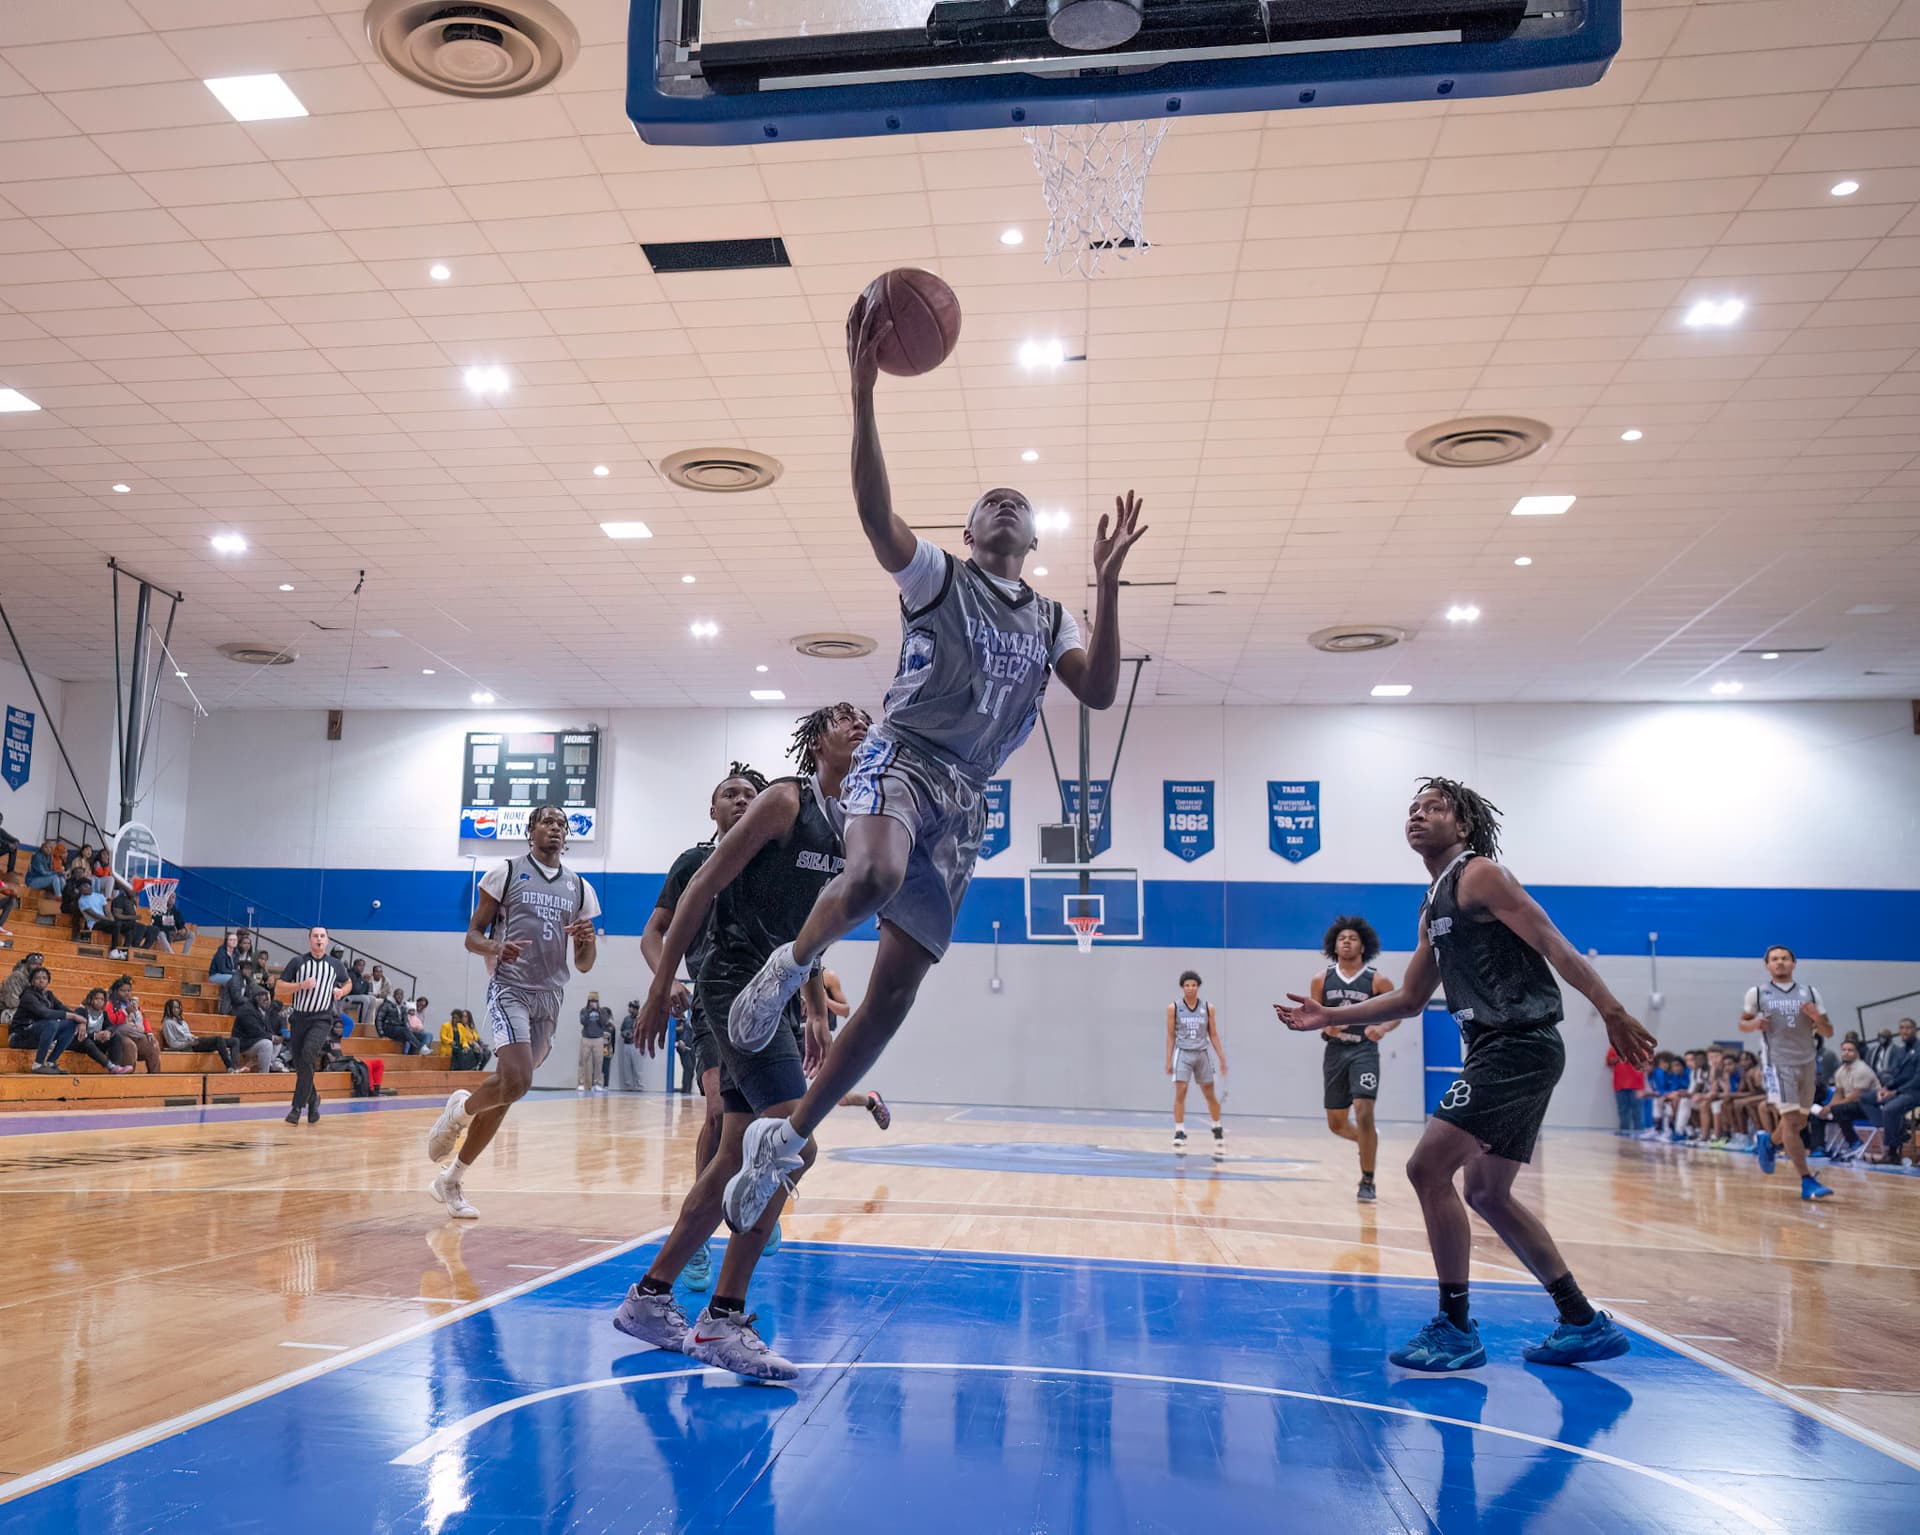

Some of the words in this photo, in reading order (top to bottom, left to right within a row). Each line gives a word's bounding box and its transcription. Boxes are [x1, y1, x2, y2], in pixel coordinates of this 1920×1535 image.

[982, 647, 1031, 684] TECH
[563, 735, 591, 743] HOME
[1282, 786, 1305, 794] TRACK
[461, 809, 498, 820] PEPSI
[503, 810, 526, 821] HOME
[1169, 813, 1208, 830] 1962
[796, 850, 830, 873] SEA
[522, 891, 573, 912] DENMARK
[535, 906, 561, 921] TECH
[543, 922, 553, 940] 5
[1786, 1015, 1797, 1028] 2
